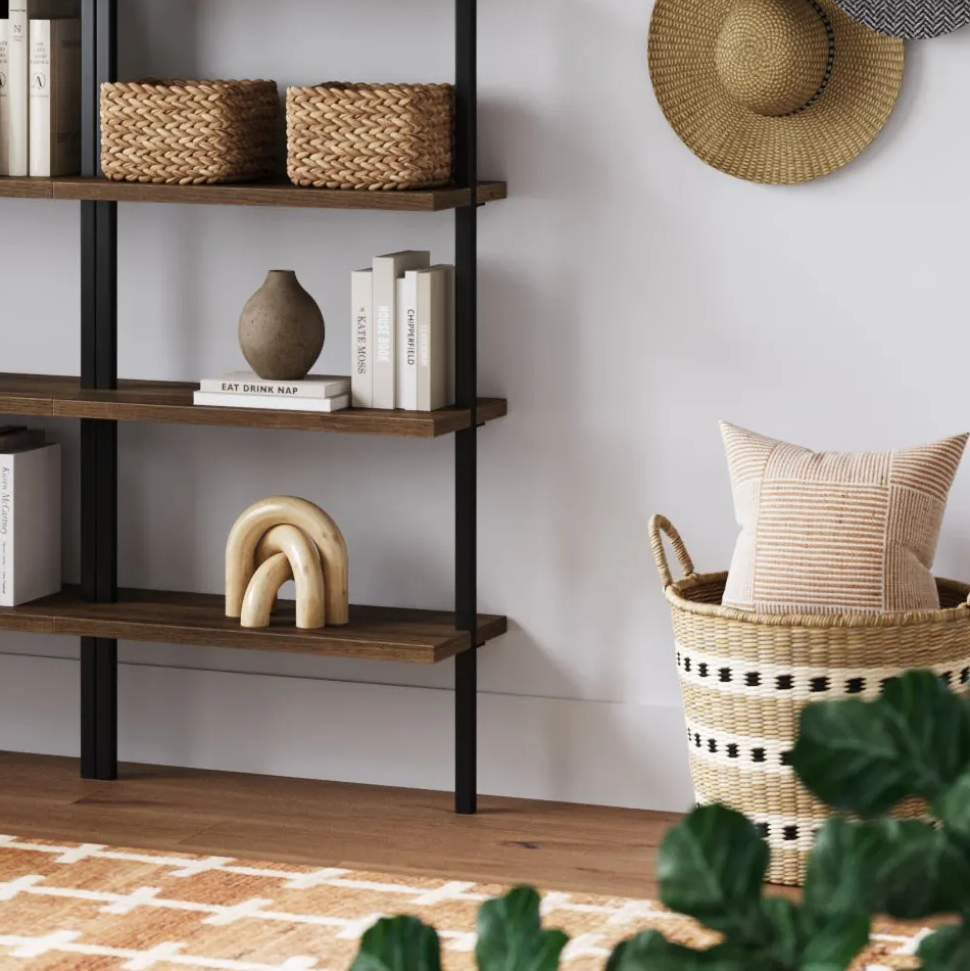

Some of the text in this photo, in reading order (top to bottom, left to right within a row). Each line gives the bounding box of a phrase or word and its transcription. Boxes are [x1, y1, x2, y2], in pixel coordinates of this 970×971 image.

[357, 315, 366, 375] KATE MOSS
[377, 306, 390, 362] HOUSE BOOK
[407, 308, 416, 366] CHIPPERFIELD
[221, 382, 298, 395] EAT DRINK NAP
